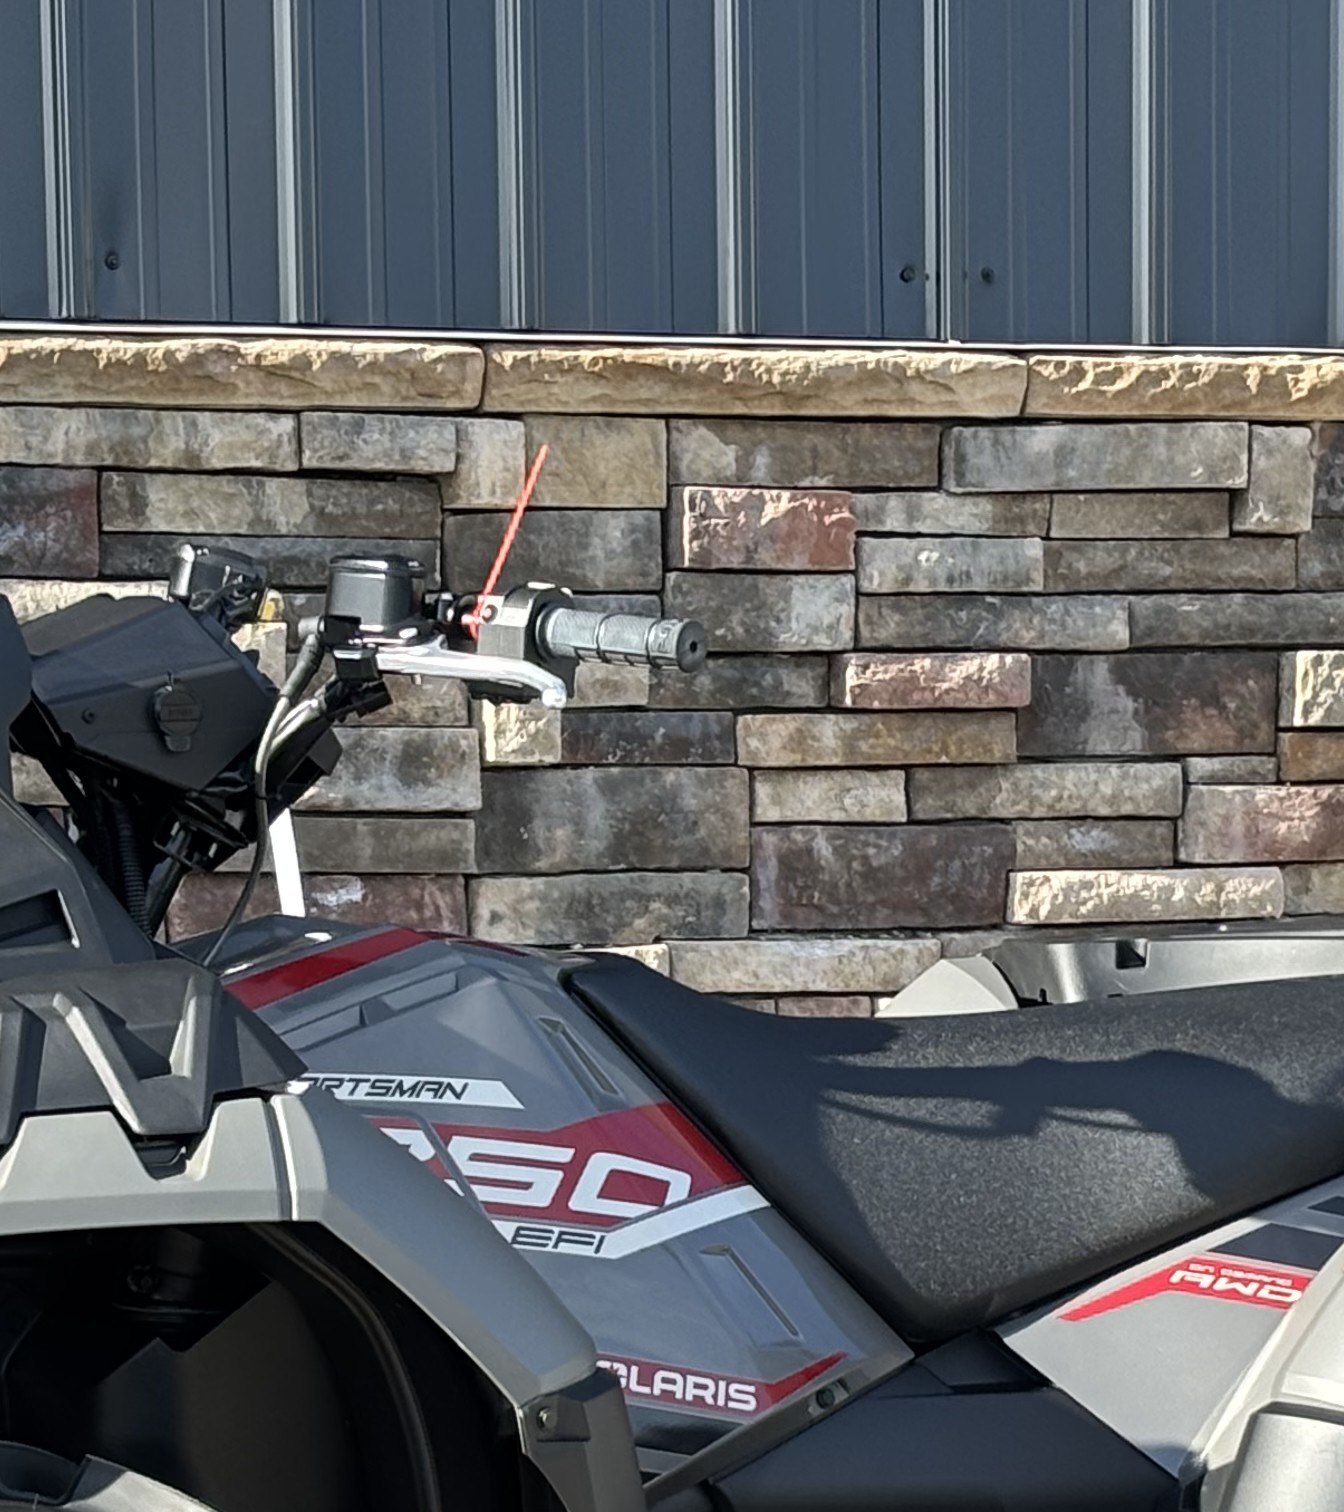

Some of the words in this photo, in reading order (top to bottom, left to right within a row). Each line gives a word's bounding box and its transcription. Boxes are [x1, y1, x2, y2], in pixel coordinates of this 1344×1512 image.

[297, 1077, 469, 1101] RTSMAN
[379, 1127, 692, 1219] 50
[509, 1226, 606, 1255] EFI
[1168, 1269, 1303, 1303] AWD
